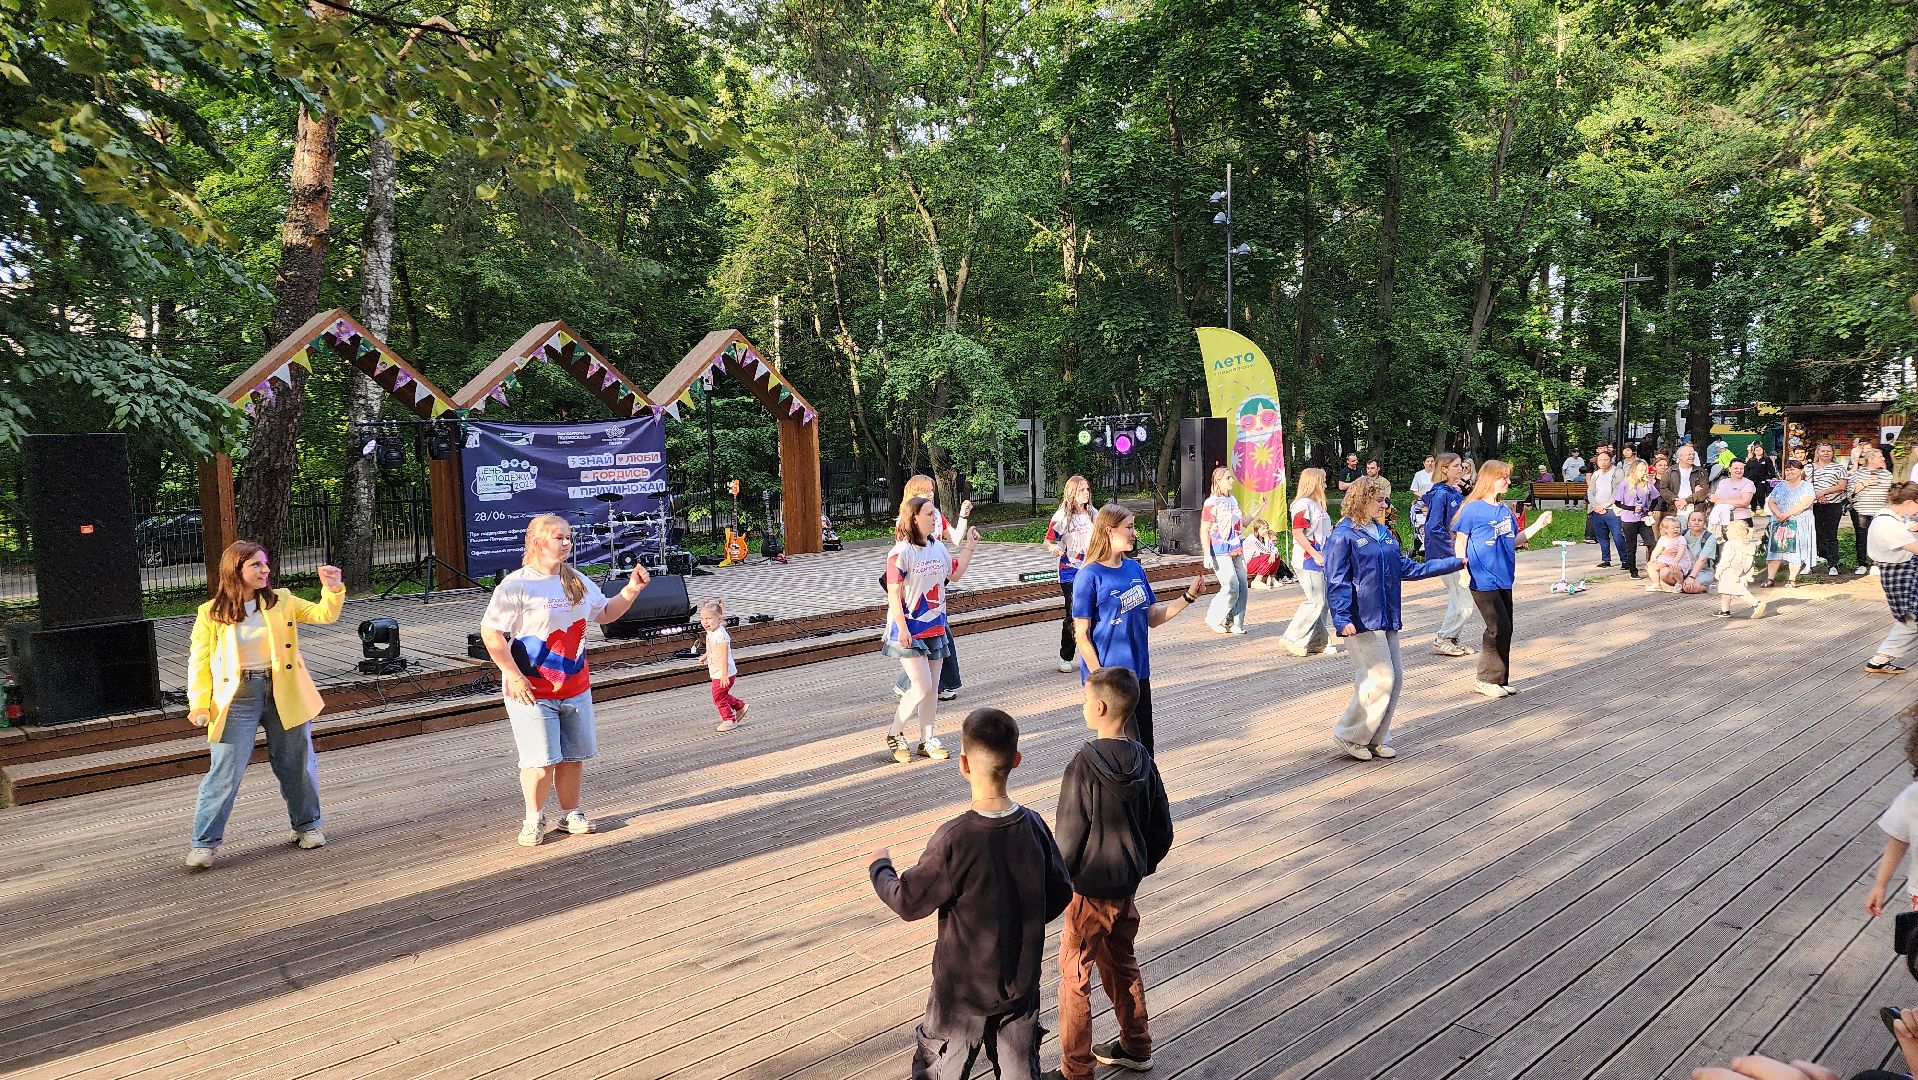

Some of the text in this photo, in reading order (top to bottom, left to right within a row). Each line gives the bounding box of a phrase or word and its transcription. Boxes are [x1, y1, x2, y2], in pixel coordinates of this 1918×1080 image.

[580, 453, 659, 466] ЗНАЙ ЛЮБИ
[592, 469, 649, 480] ГОРДИСЬ
[580, 480, 664, 496] ПРИУМНОЖАЙ
[474, 511, 506, 522] 28/06
